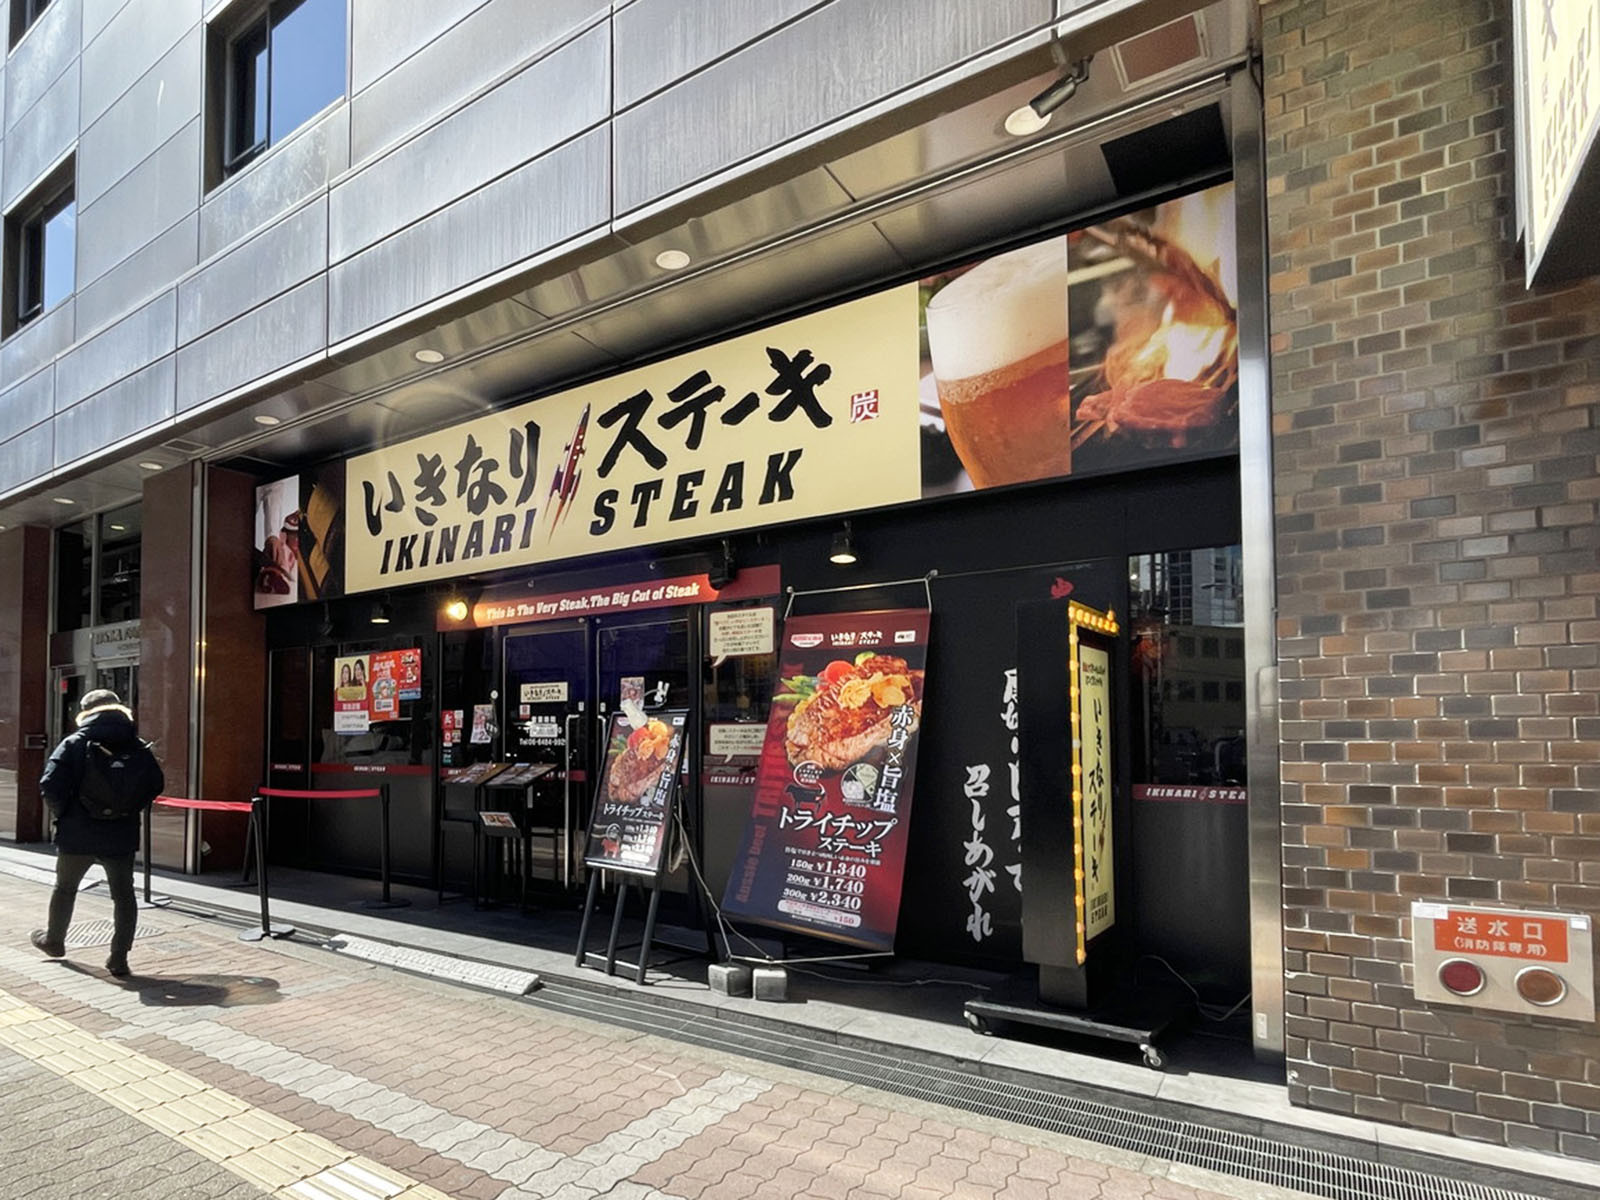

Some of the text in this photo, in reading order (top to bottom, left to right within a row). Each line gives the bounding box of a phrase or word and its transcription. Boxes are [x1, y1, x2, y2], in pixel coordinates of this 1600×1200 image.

[850, 389, 879, 423] 炭
[362, 346, 833, 536] いきなり ステーキ
[380, 448, 803, 574] IKINARI STEAK
[486, 607, 505, 620] This
[507, 607, 515, 618] is
[517, 604, 535, 616] The
[536, 602, 558, 615] Very
[612, 593, 630, 608] Big
[631, 588, 650, 603] Cut
[652, 586, 664, 601] of
[665, 582, 699, 599] Steak
[1146, 787, 1247, 800] IKINARI STEA
[778, 806, 898, 840] トライチップ
[818, 836, 882, 858] ステーキ
[962, 763, 997, 942] 召しあがれ
[790, 858, 814, 871] 150g
[783, 887, 807, 901] 300g
[786, 873, 811, 887] 200g
[1456, 916, 1543, 941] 送水口
